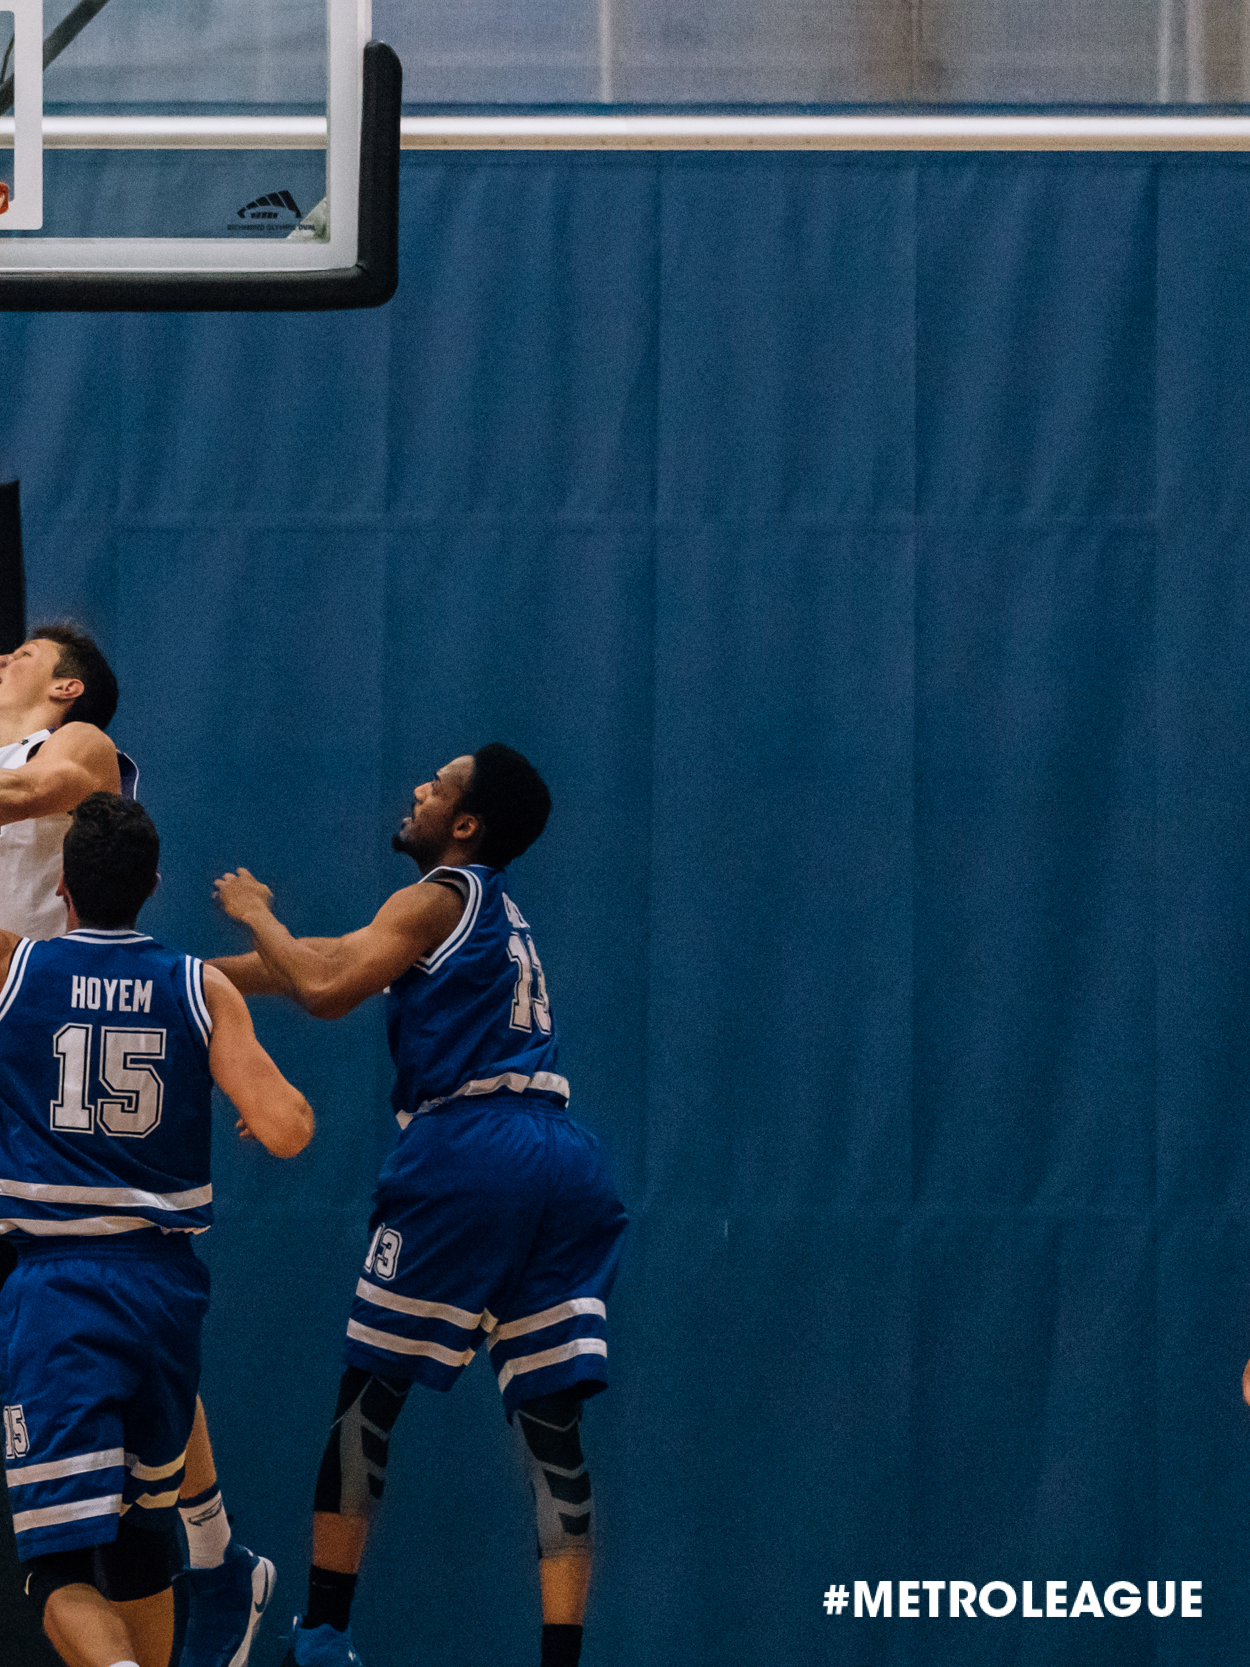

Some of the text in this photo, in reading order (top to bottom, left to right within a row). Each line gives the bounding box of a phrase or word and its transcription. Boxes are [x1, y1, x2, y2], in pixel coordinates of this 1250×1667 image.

[71, 974, 153, 1014] HOYEM
[50, 1022, 167, 1139] 15
[363, 1222, 403, 1281] 13
[3, 1404, 30, 1460] 15
